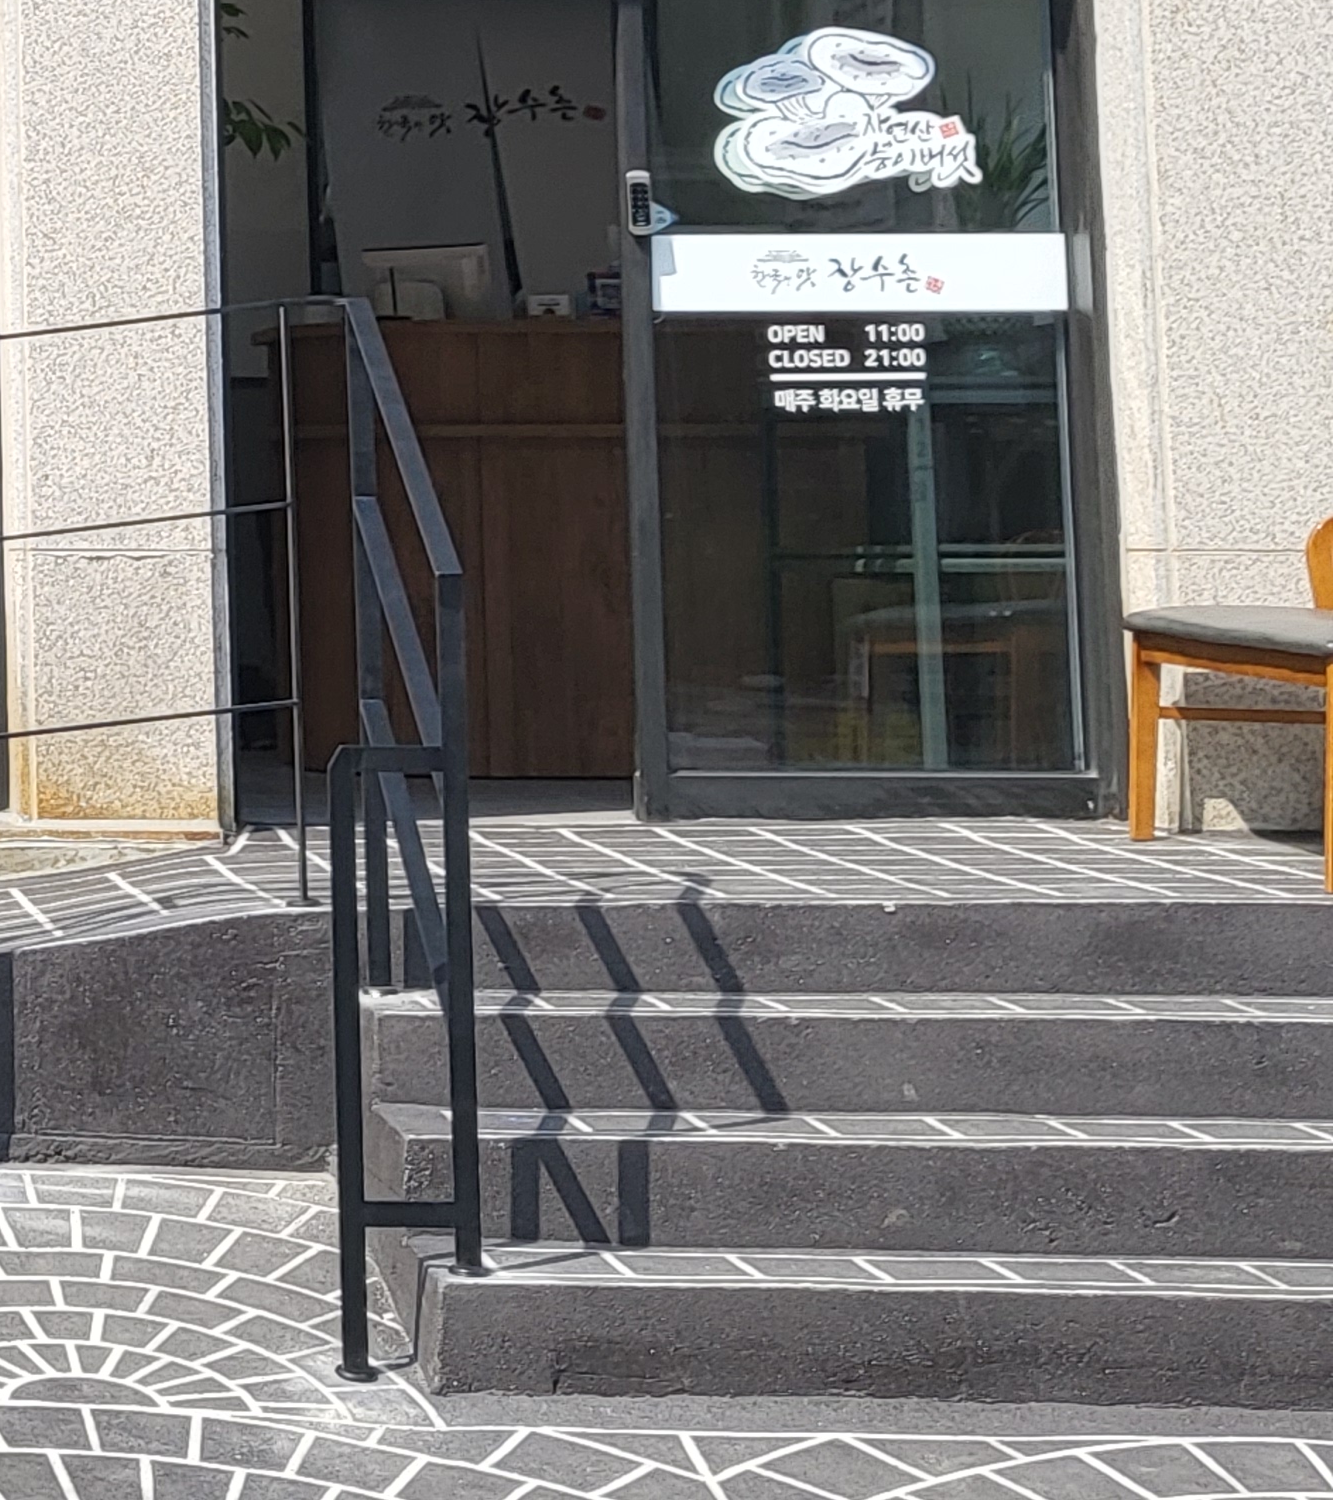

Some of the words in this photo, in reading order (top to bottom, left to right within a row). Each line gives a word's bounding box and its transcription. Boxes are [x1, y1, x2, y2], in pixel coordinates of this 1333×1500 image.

[862, 113, 935, 143] 자연산
[827, 253, 921, 293] 장수촌
[767, 325, 825, 343] OPEN
[864, 323, 926, 342] 11:00
[768, 349, 851, 368] CLOSED
[863, 348, 927, 367] 21:00
[773, 388, 817, 412] 매주
[817, 387, 879, 413] 화요일
[883, 386, 925, 412] 휴무
